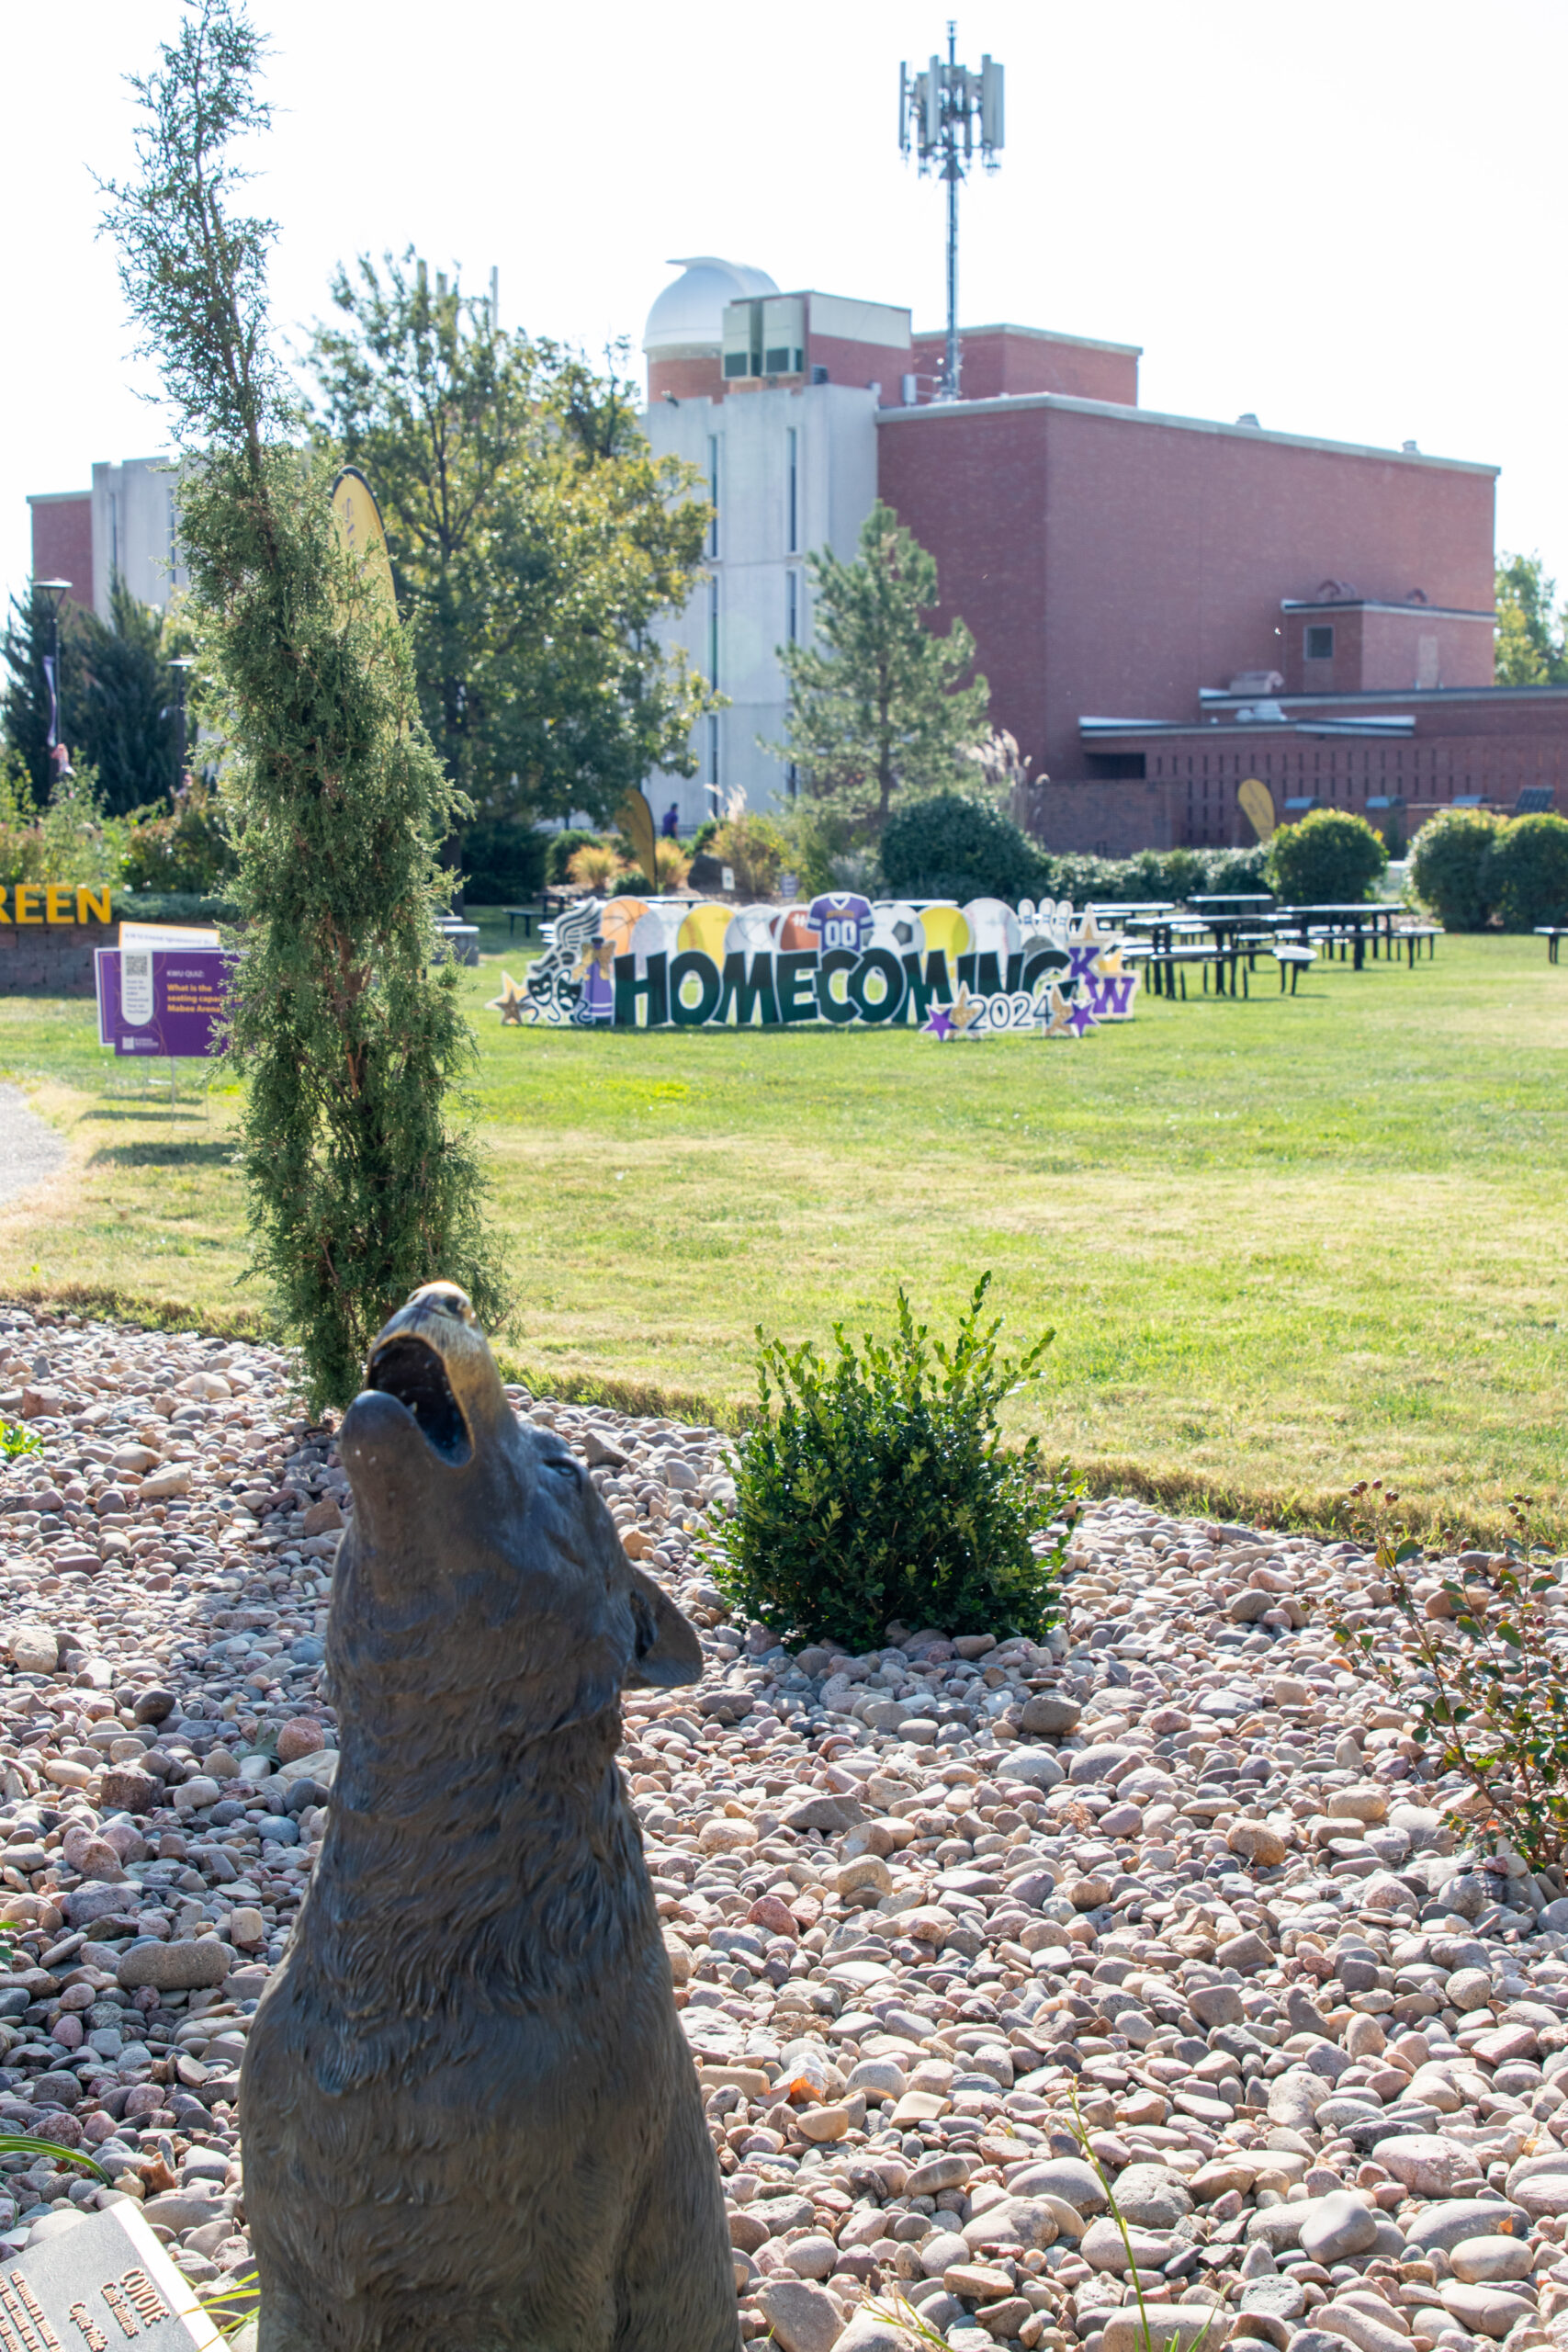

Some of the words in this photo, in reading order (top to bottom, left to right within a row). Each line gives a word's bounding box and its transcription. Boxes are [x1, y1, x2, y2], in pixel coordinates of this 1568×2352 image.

[824, 920, 857, 947] 00
[166, 984, 188, 992] What
[190, 984, 197, 992] is
[198, 983, 212, 992] the
[166, 995, 197, 1004] seating
[614, 947, 1078, 1025] HOMECOMING
[967, 995, 1054, 1029] 2024
[101, 2281, 123, 2307] Canis
[119, 2267, 171, 2327] COYOTE
[70, 2301, 94, 2332] Coyote
